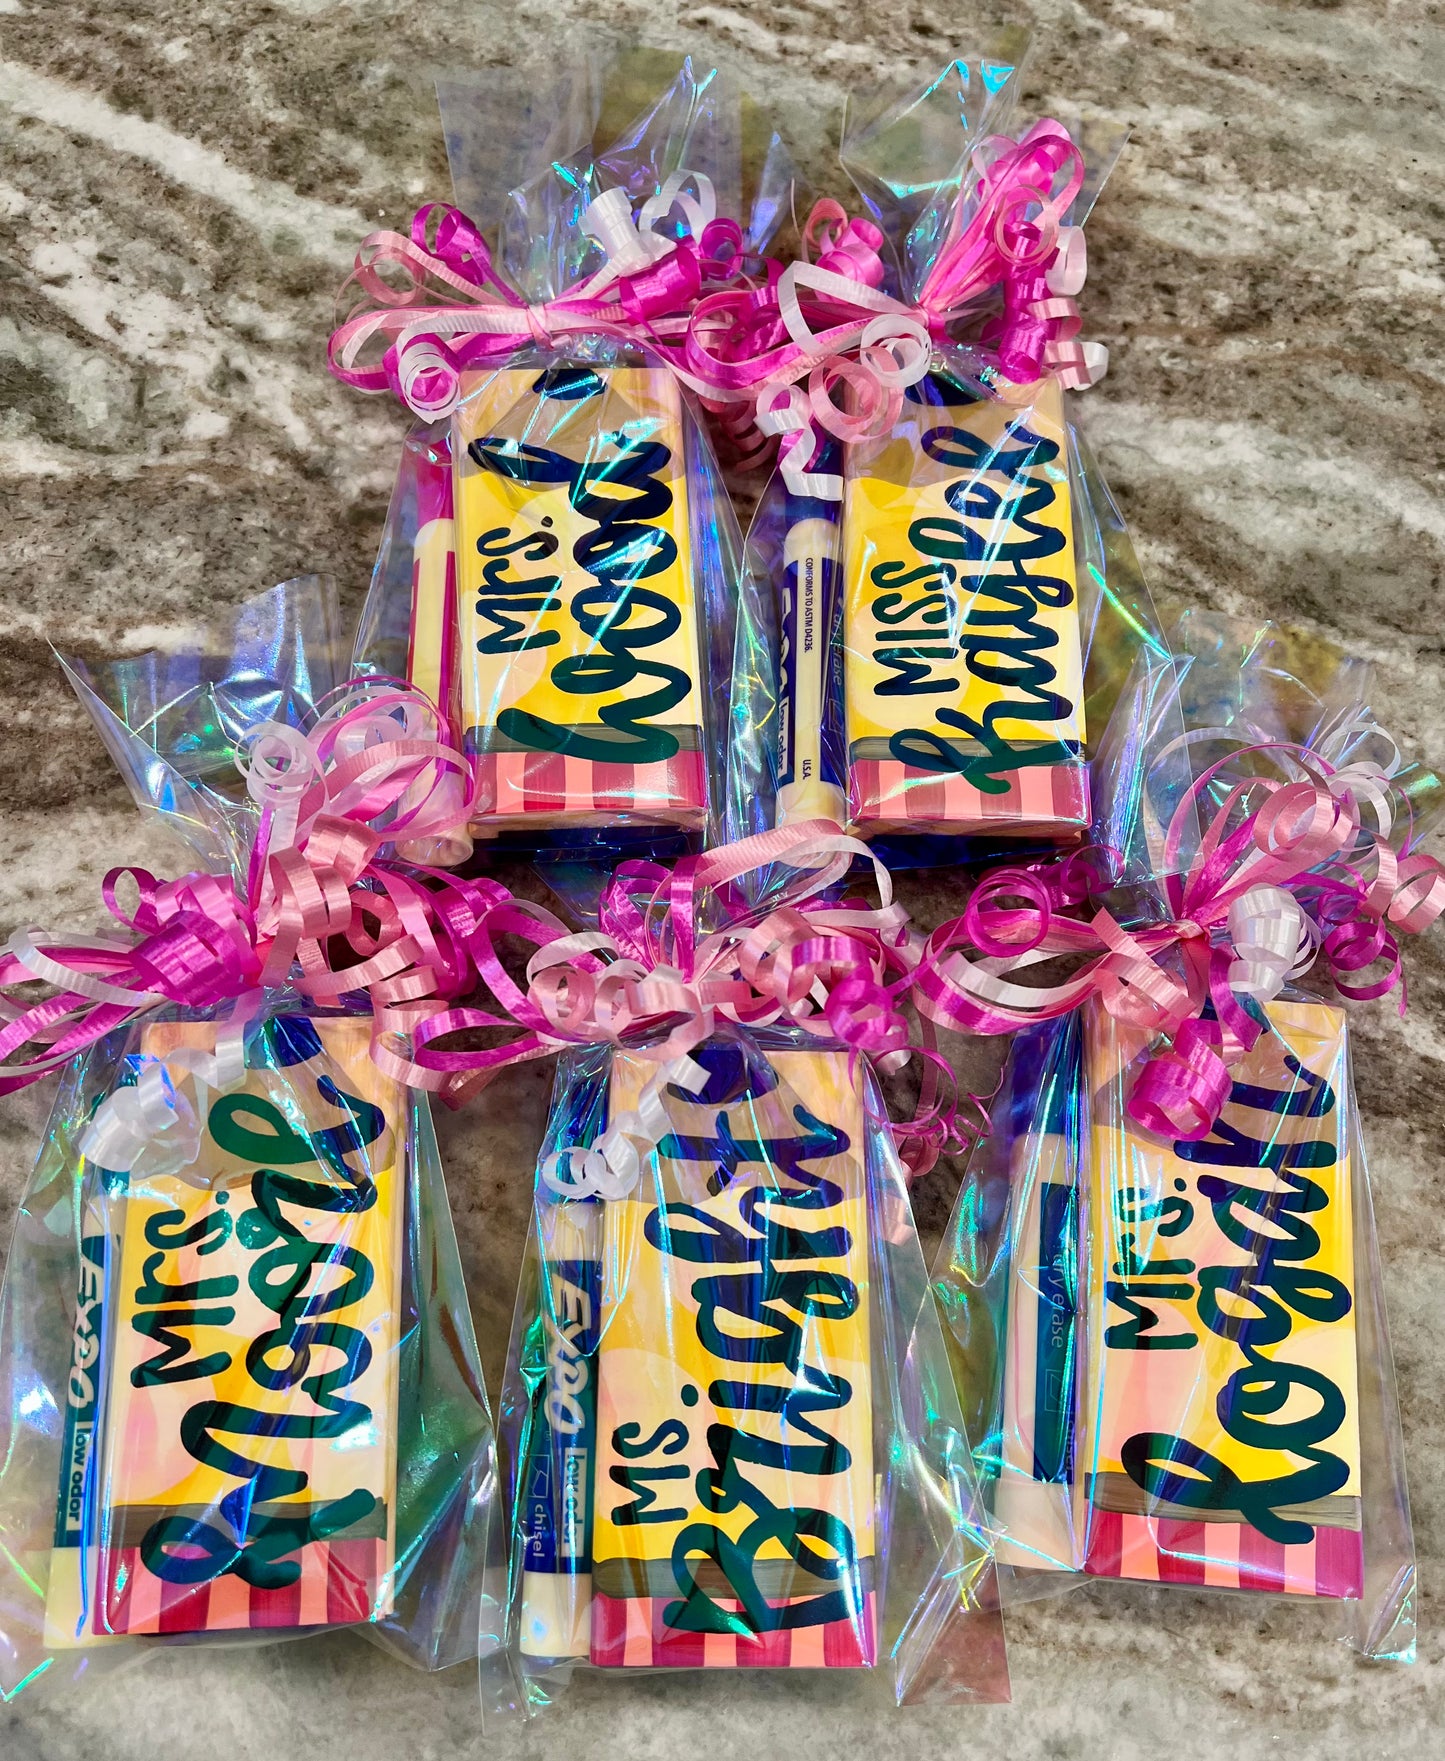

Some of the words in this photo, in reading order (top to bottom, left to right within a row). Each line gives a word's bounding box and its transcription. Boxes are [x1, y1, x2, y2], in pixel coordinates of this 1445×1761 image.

[475, 515, 562, 655] Mrs.
[804, 557, 814, 597] CONFORMS
[804, 597, 813, 606] TO
[804, 607, 813, 627] ASTM
[804, 628, 813, 653] D4236.
[802, 759, 811, 780] U.S.A.
[1106, 1177, 1200, 1351] Mrs.
[131, 1190, 239, 1389] Mrs.
[1051, 1293, 1065, 1349] erase
[644, 1104, 864, 1636] Bright
[74, 1427, 93, 1467] low
[566, 1454, 586, 1491] low
[69, 1470, 87, 1522] odor
[532, 1503, 547, 1558] chisel
